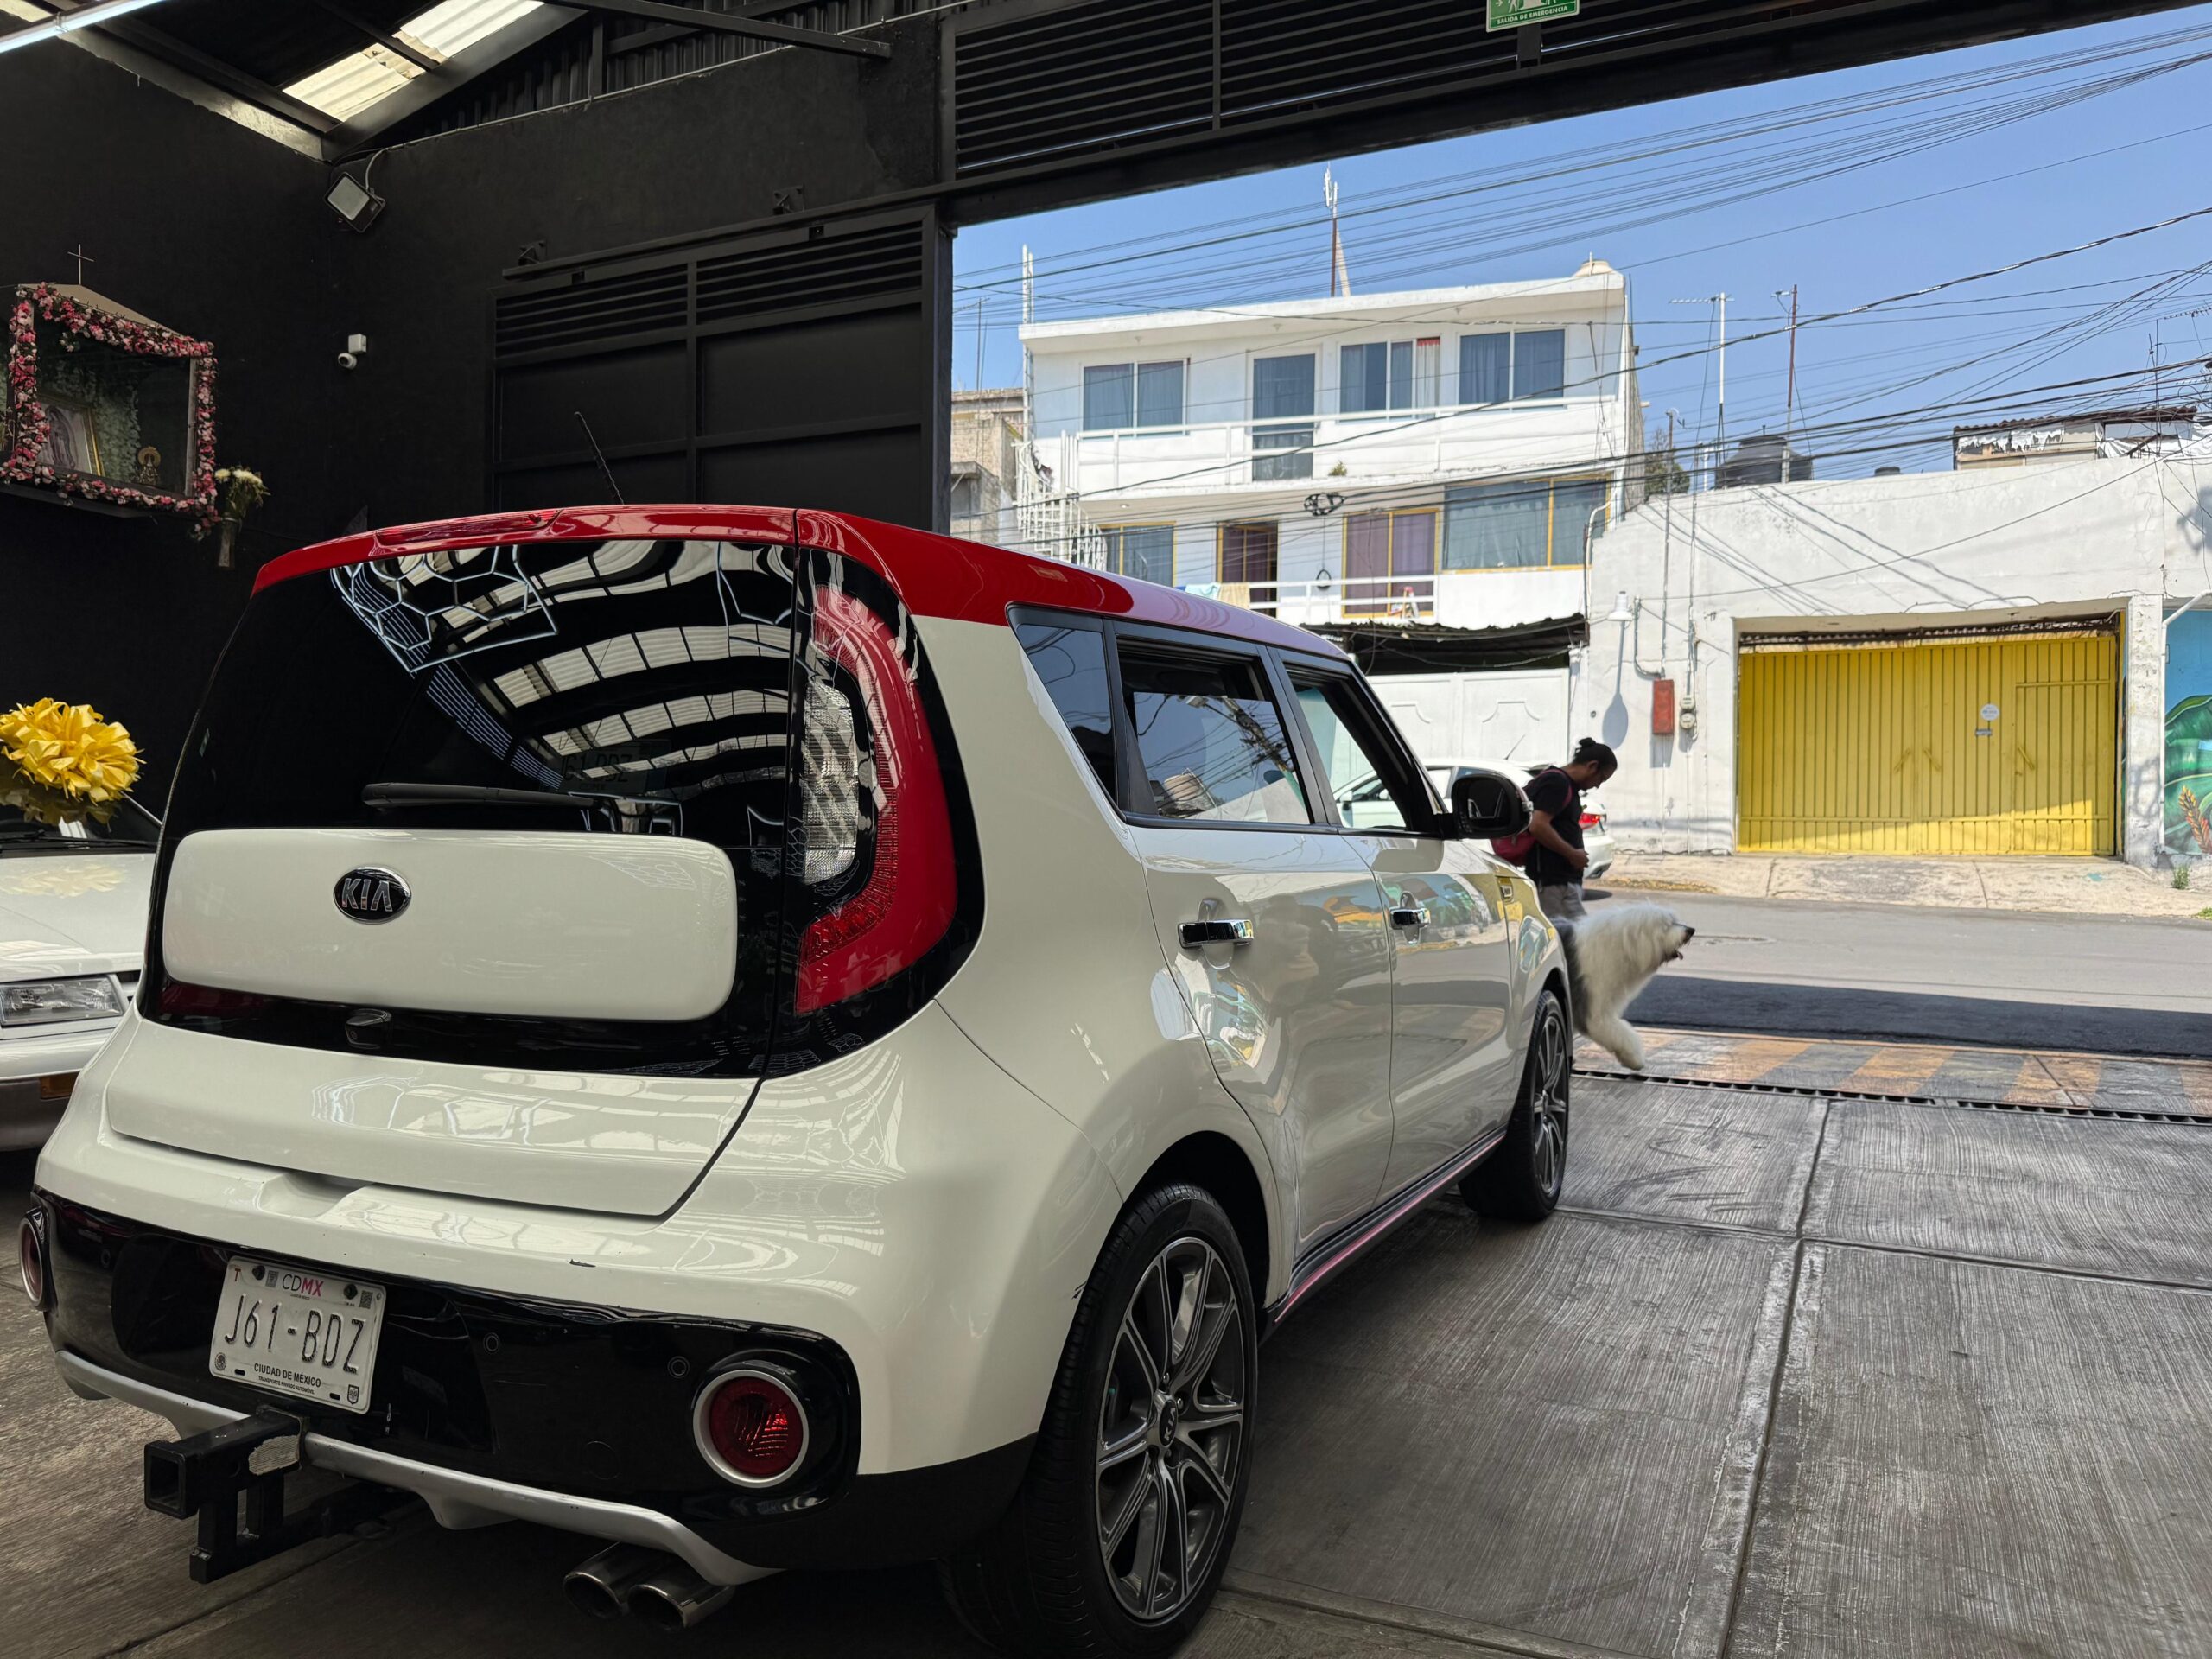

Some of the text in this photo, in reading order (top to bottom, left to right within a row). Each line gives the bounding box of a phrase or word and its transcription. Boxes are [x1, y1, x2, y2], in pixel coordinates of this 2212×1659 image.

[1497, 16, 1518, 24] SALIDA
[1529, 6, 1568, 17] EMERGENCIA
[341, 878, 393, 912] KIA
[234, 1268, 241, 1281] T
[282, 1274, 324, 1297] CDMX
[224, 1294, 366, 1375] J61-BDZ
[254, 1363, 321, 1388] CIUDAD DE MÉXICO
[258, 1376, 281, 1386] TRANSPORTE
[1164, 1407, 1176, 1441] KIA
